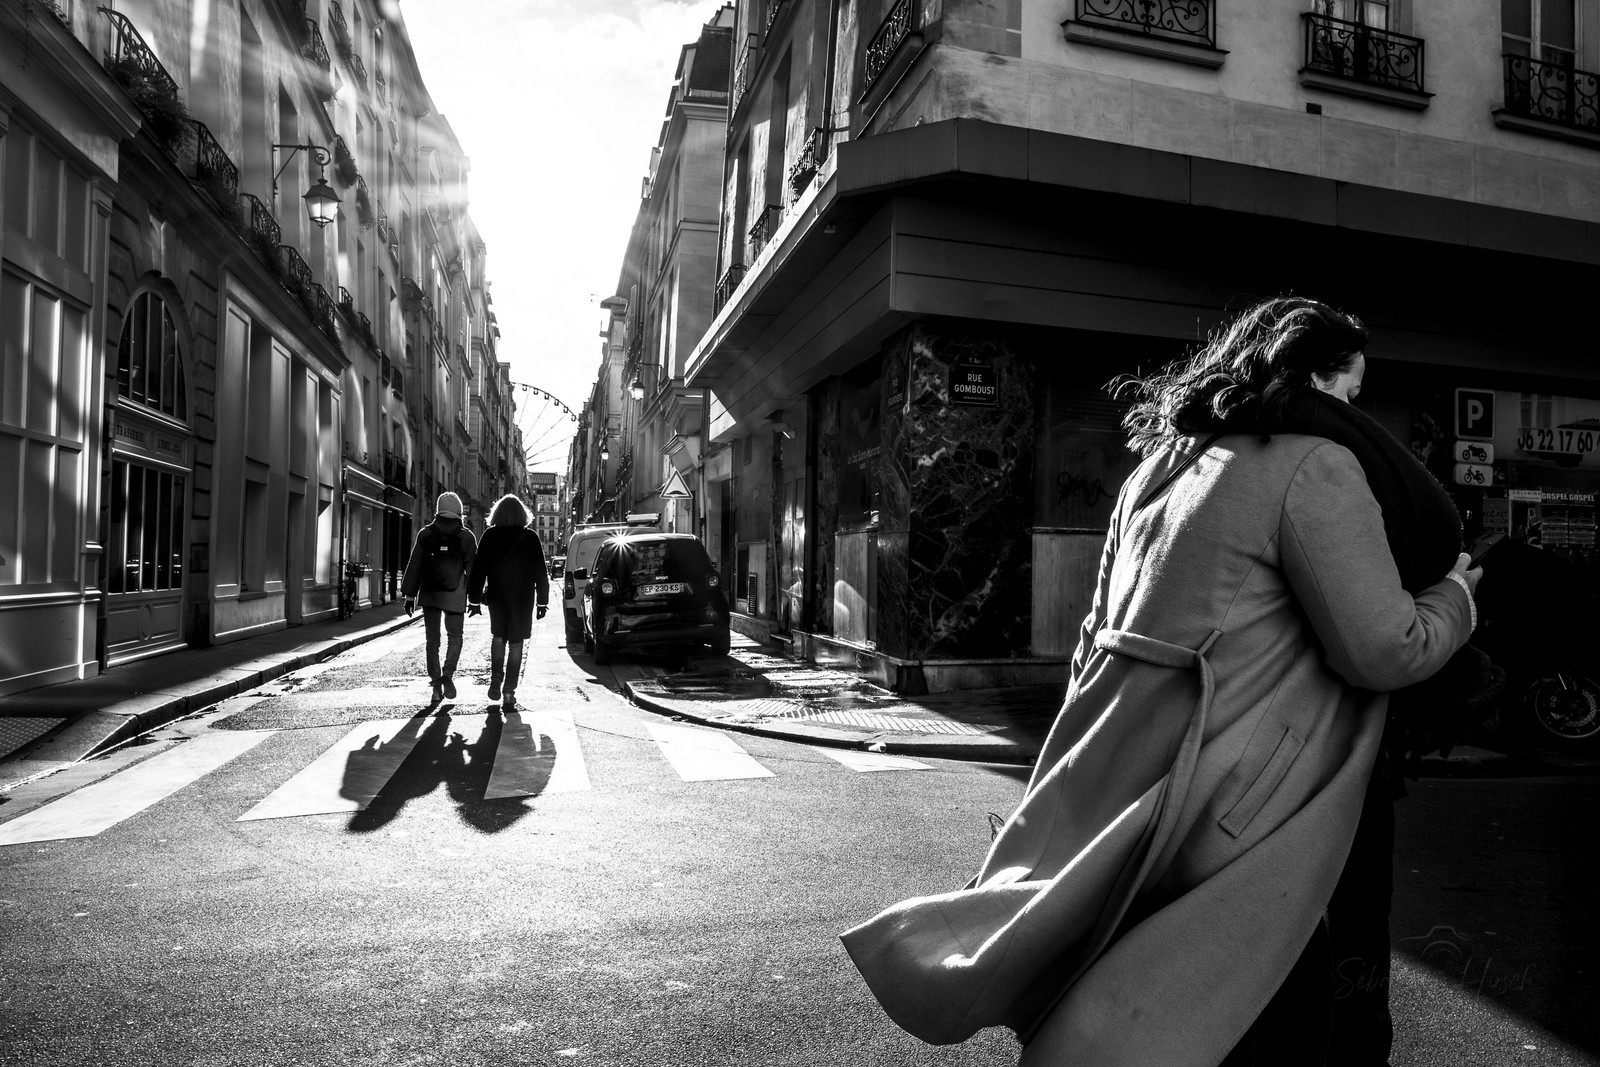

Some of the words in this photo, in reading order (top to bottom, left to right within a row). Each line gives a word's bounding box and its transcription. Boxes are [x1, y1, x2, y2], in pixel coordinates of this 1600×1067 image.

[967, 373, 983, 383] RUE
[954, 384, 996, 395] GOMBOUST
[1467, 399, 1484, 429] P
[1538, 429, 1553, 450] 22
[1559, 430, 1573, 452] 17
[1577, 431, 1593, 453] 60
[1541, 492, 1568, 500] GOSPEL
[1569, 493, 1595, 502] GOSPEL
